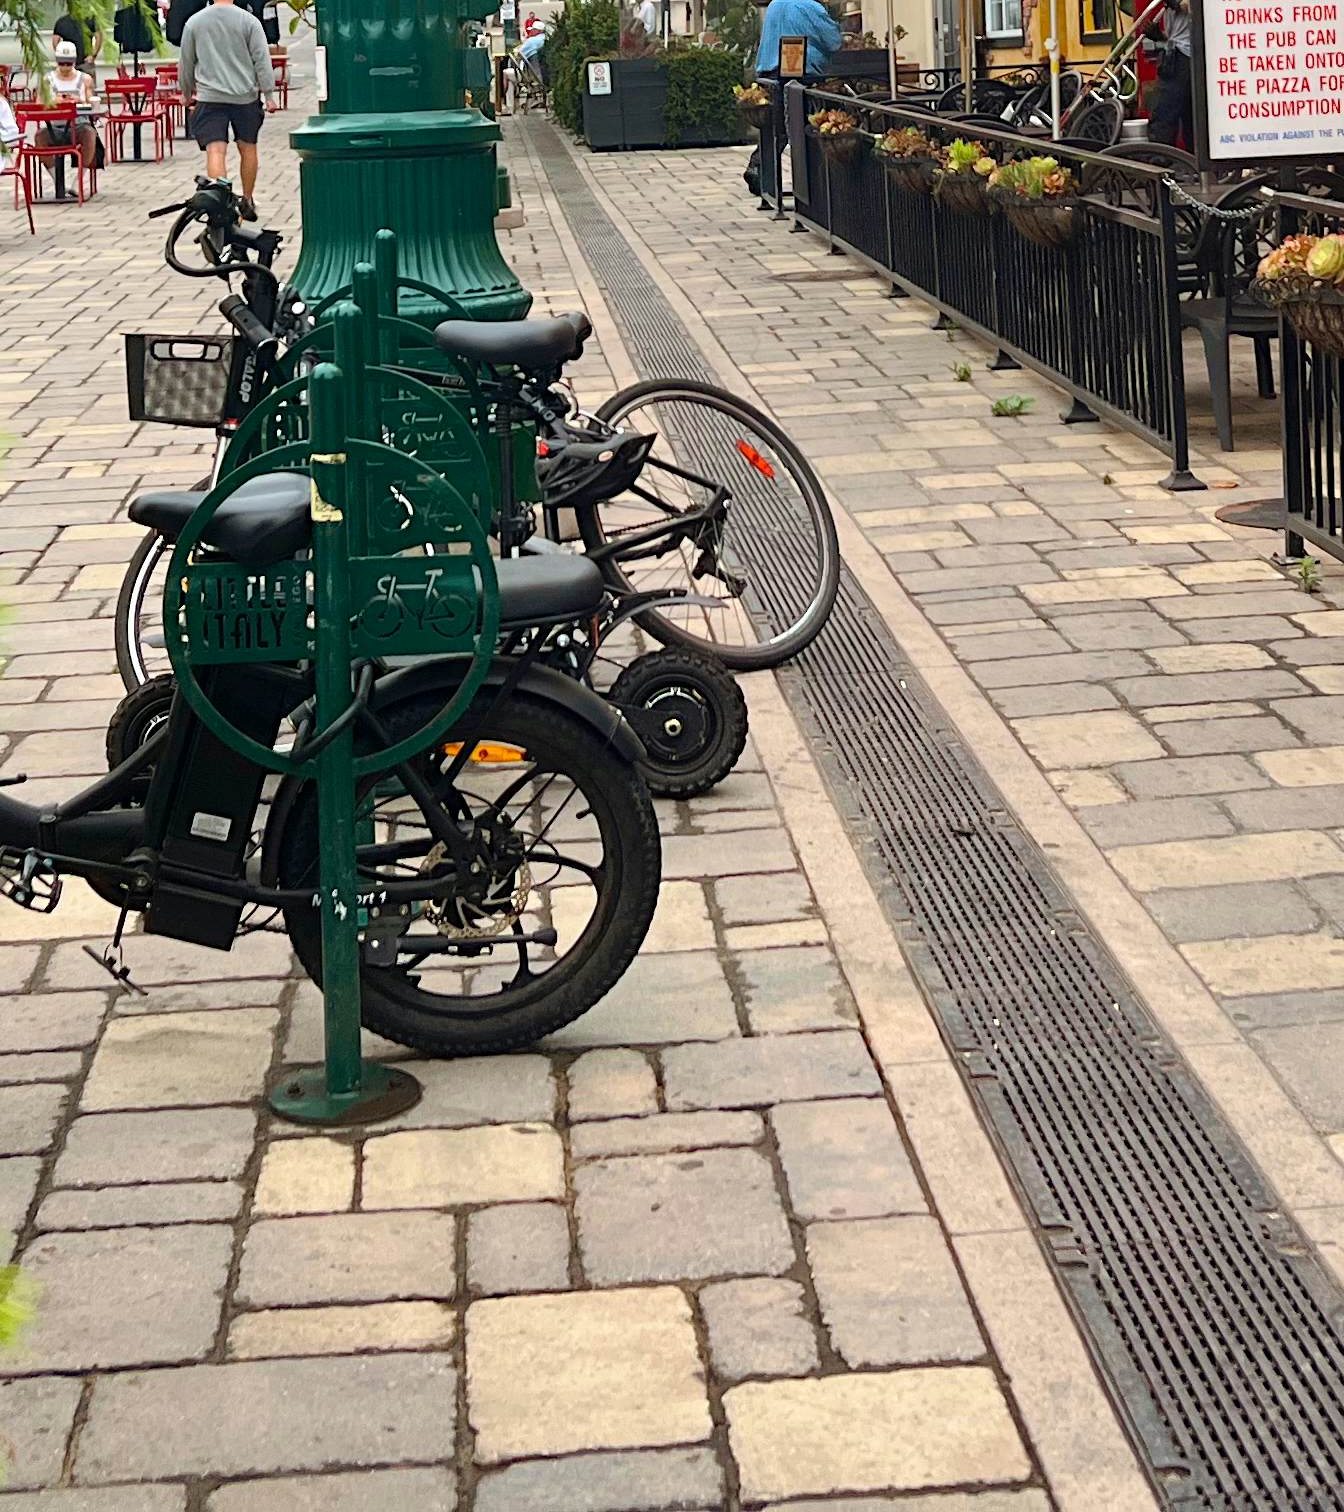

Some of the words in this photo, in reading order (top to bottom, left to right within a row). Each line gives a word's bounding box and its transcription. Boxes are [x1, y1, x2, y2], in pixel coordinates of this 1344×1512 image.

[1225, 7, 1284, 25] DRINKS
[1293, 5, 1337, 23] FROM
[1227, 33, 1256, 49] THE
[1266, 31, 1297, 48] PUB
[1305, 29, 1336, 46] CAN
[1219, 57, 1238, 73] BE
[1249, 55, 1296, 72] TAKEN
[1305, 52, 1344, 69] ONTO
[1217, 80, 1246, 97] THE
[1256, 77, 1311, 95] PIAZZA
[1228, 98, 1342, 119] CONSUMPTION
[1239, 132, 1279, 143] VIOLATION
[1282, 130, 1315, 140] AGAINST
[1318, 128, 1333, 137] THE
[203, 610, 287, 650] ITALY
